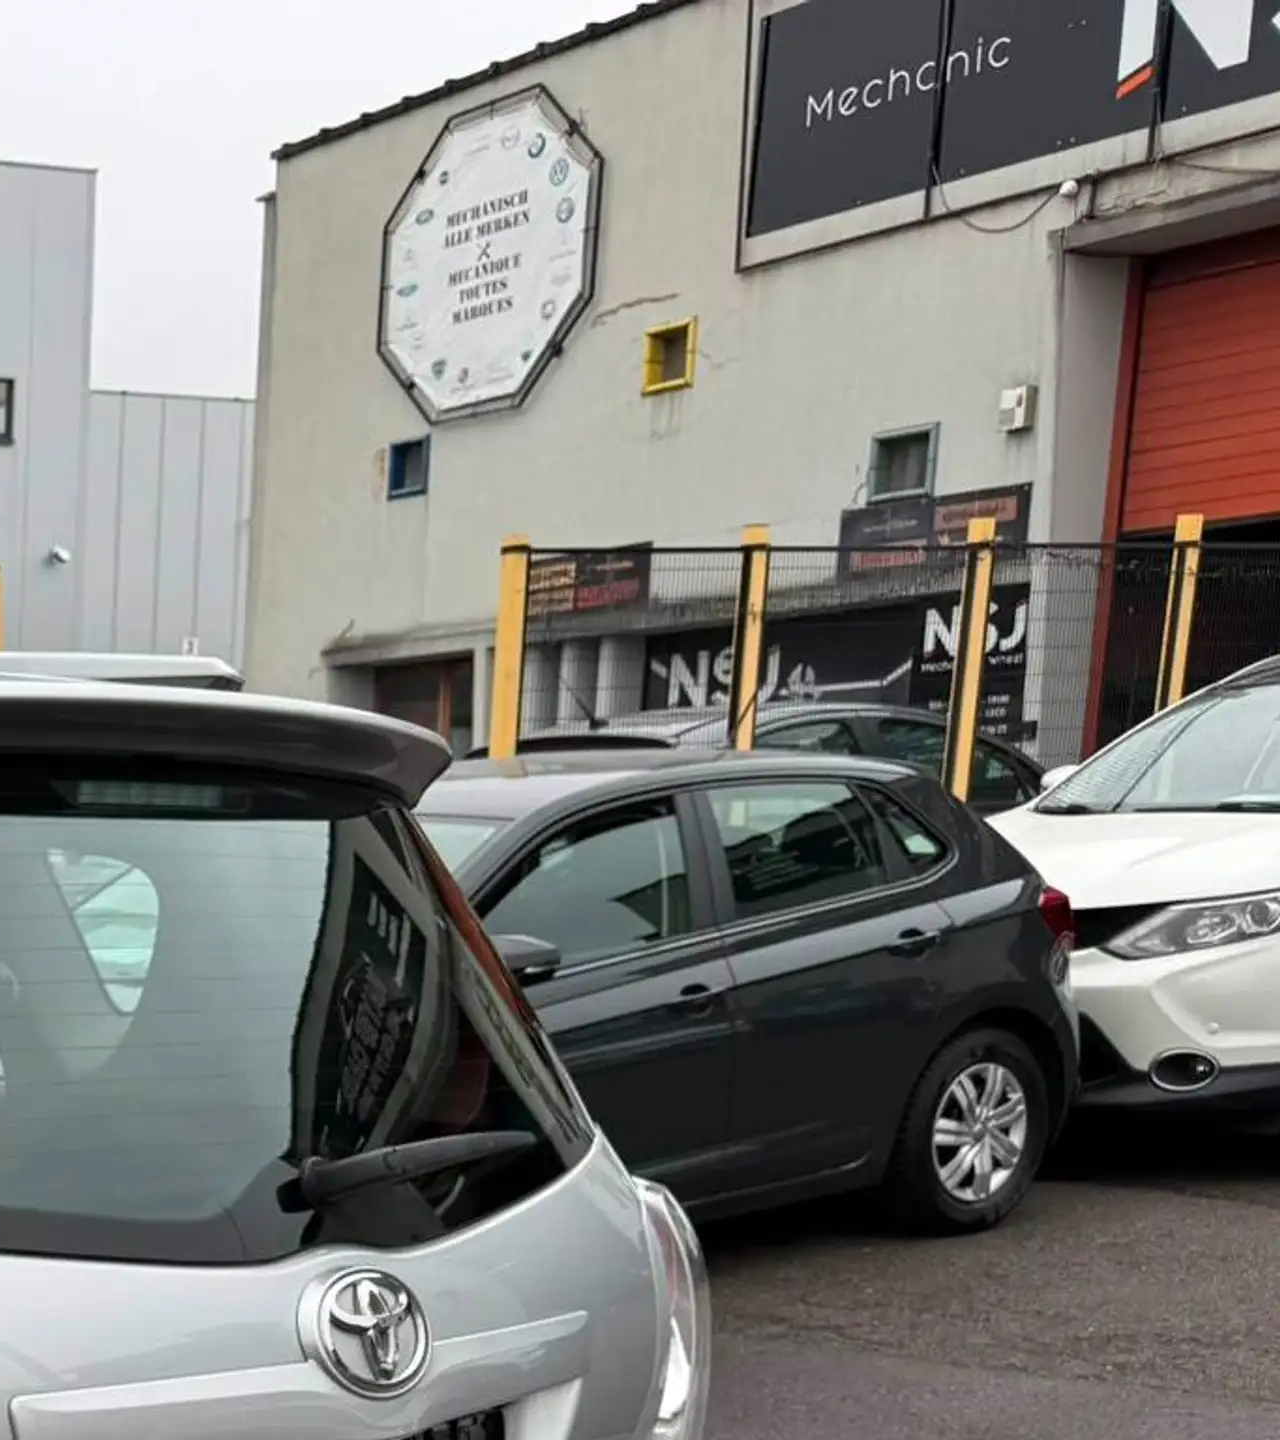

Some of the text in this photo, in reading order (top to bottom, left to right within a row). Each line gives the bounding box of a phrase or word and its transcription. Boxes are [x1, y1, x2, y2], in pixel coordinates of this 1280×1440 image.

[447, 190, 527, 227] MECHANISCH
[445, 210, 530, 248] ALLE MERKEN
[449, 253, 521, 286] MECANIQUE
[460, 280, 508, 303] TOUTES
[453, 299, 512, 325] MARQUES
